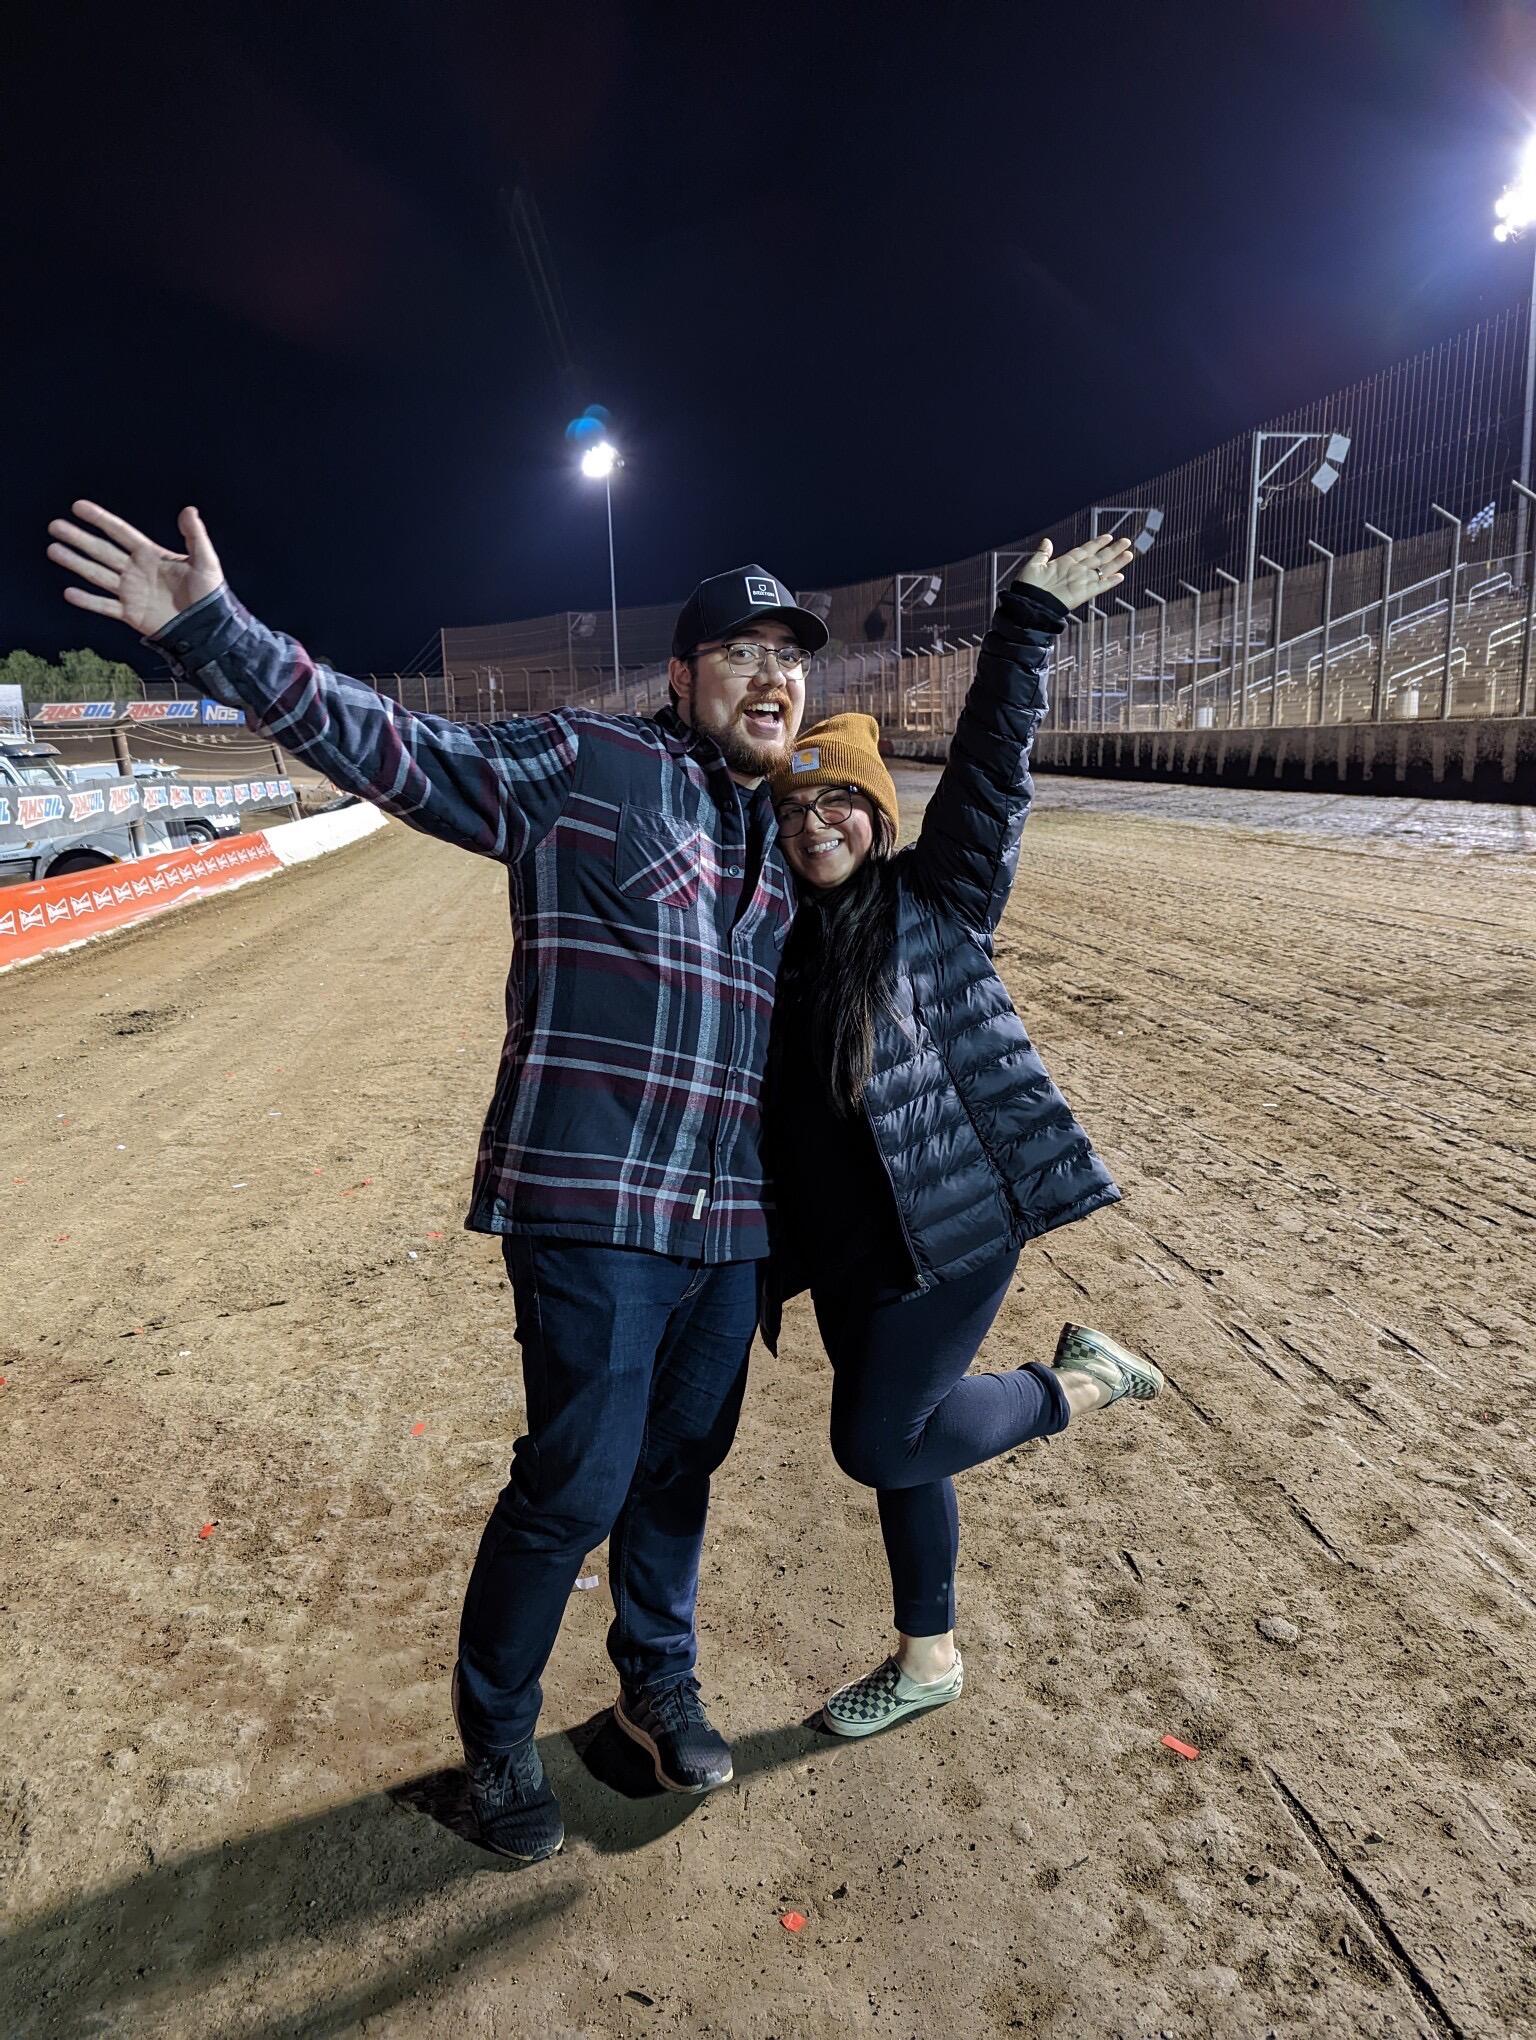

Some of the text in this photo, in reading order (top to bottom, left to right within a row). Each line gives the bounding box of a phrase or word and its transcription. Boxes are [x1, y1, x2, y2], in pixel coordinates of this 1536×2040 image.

[37, 703, 115, 722] AMSOIL
[122, 703, 197, 720] AMSOIL
[18, 796, 63, 828] AMSOIL
